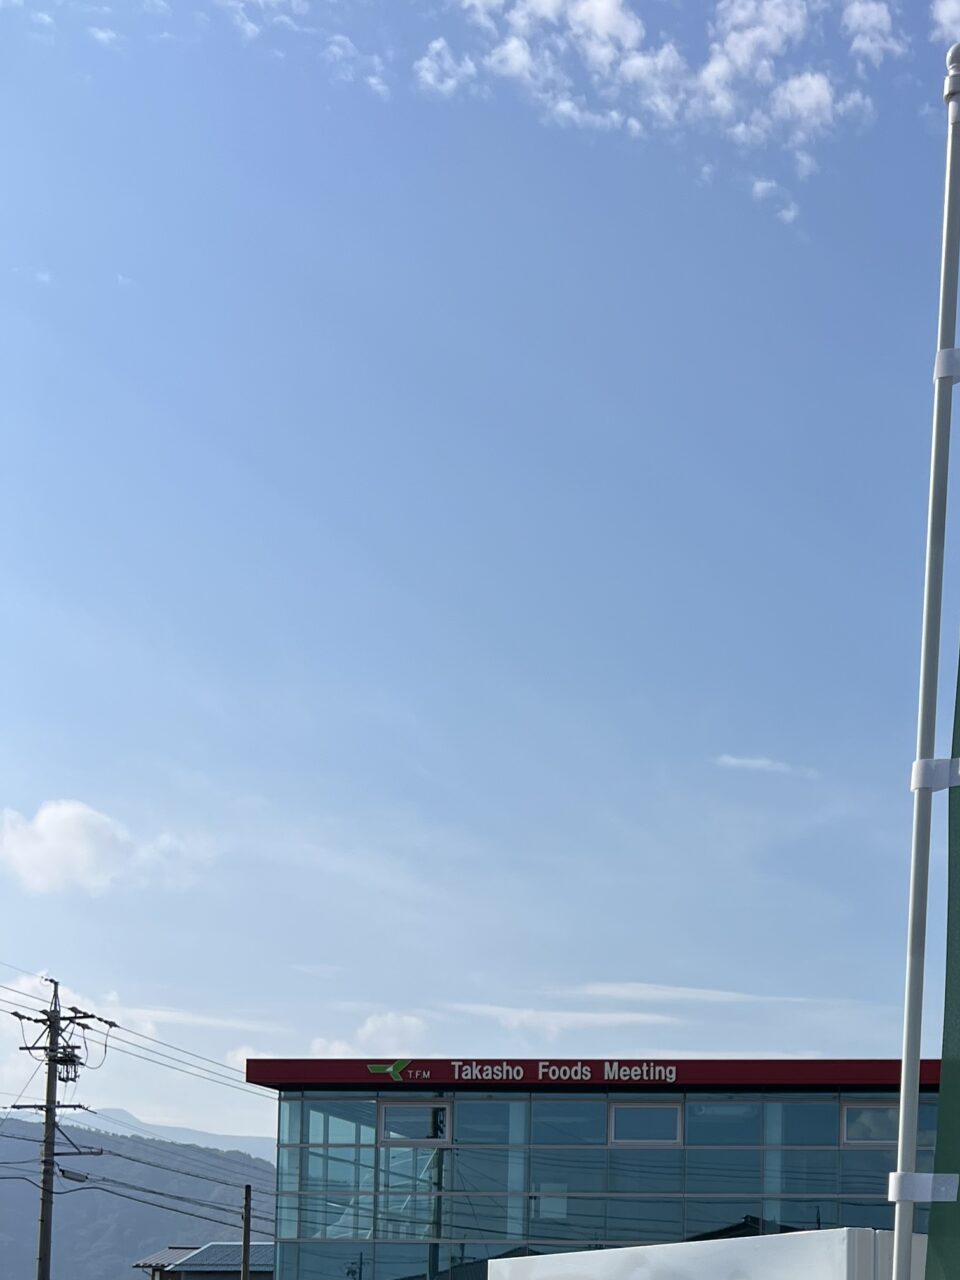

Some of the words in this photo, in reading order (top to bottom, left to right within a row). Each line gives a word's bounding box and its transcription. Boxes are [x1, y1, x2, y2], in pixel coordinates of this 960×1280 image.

[450, 1061, 524, 1080] Takasho
[537, 1060, 592, 1081] Foods
[603, 1061, 677, 1083] Meeting
